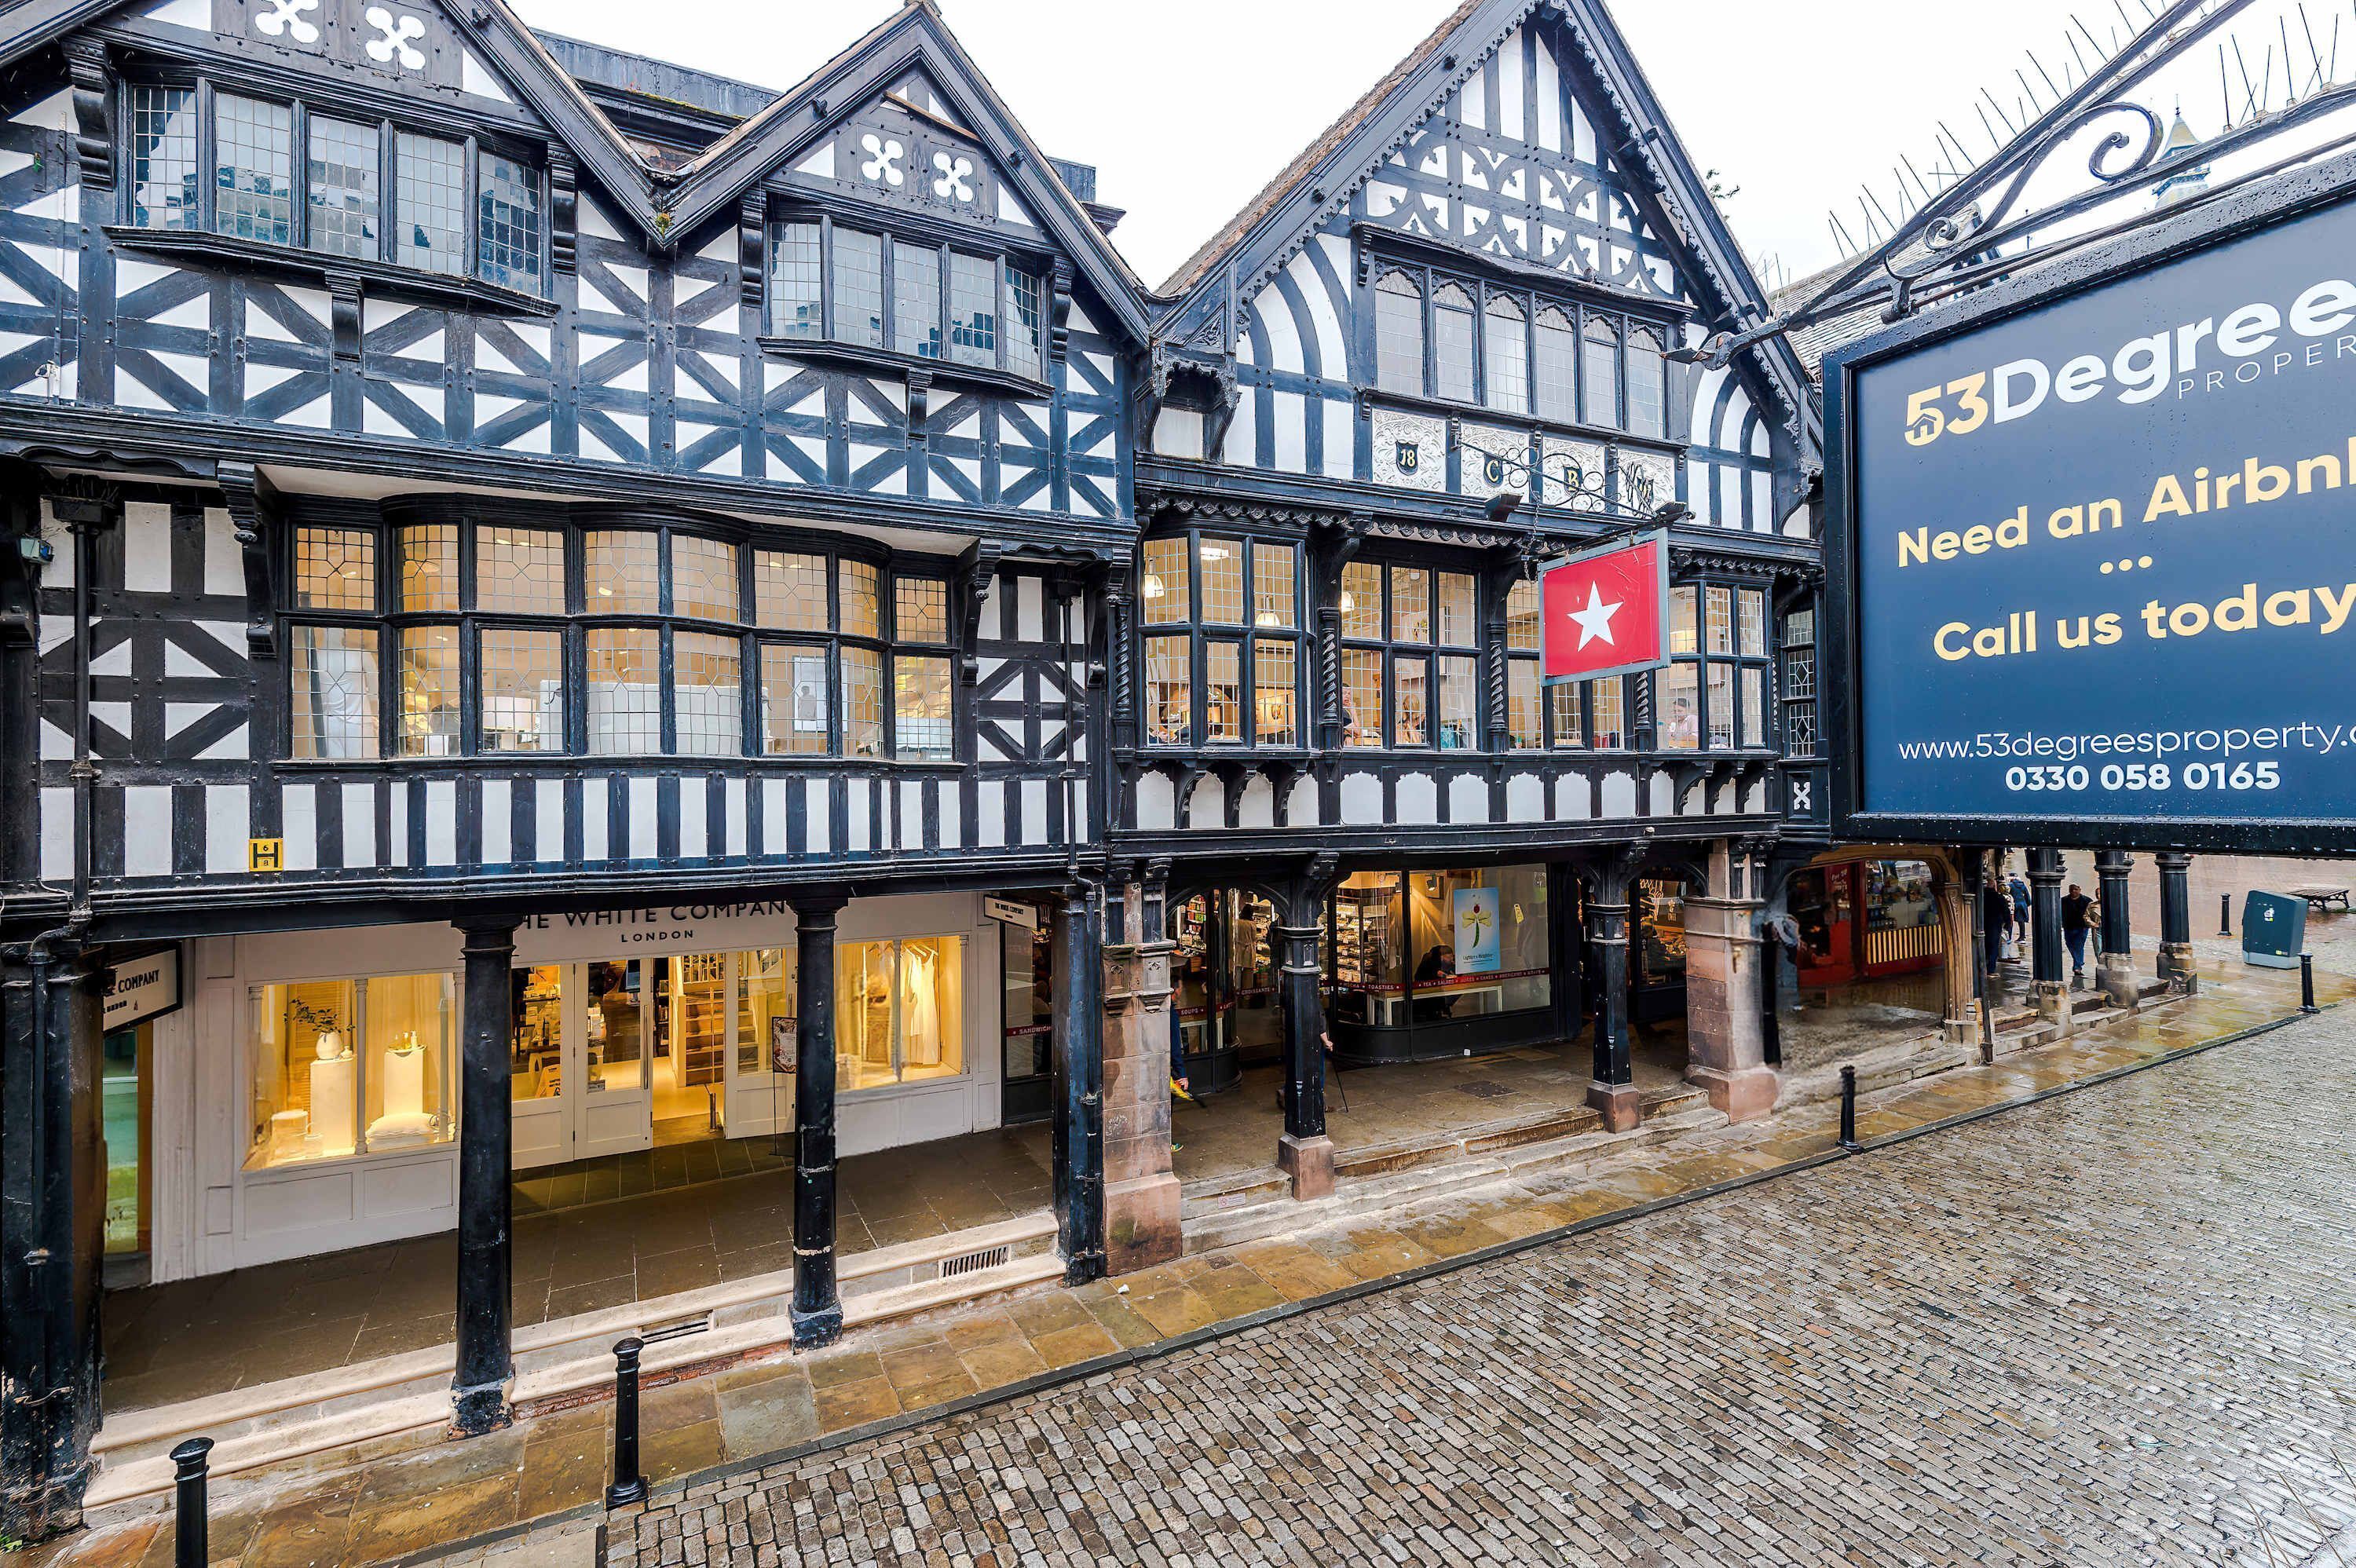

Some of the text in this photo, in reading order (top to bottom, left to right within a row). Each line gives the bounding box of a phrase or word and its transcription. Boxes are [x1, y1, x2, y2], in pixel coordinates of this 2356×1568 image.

[2178, 334, 2356, 400] PROPER
[1400, 448, 1579, 491] 18 C B
[1897, 437, 2356, 568] Need an Airbn
[1933, 583, 2356, 661] Call us today
[2005, 761, 2281, 791] 0330 058 0165
[671, 902, 785, 921] COMPAN
[621, 930, 694, 943] LONDON
[118, 969, 160, 993] COMPANY
